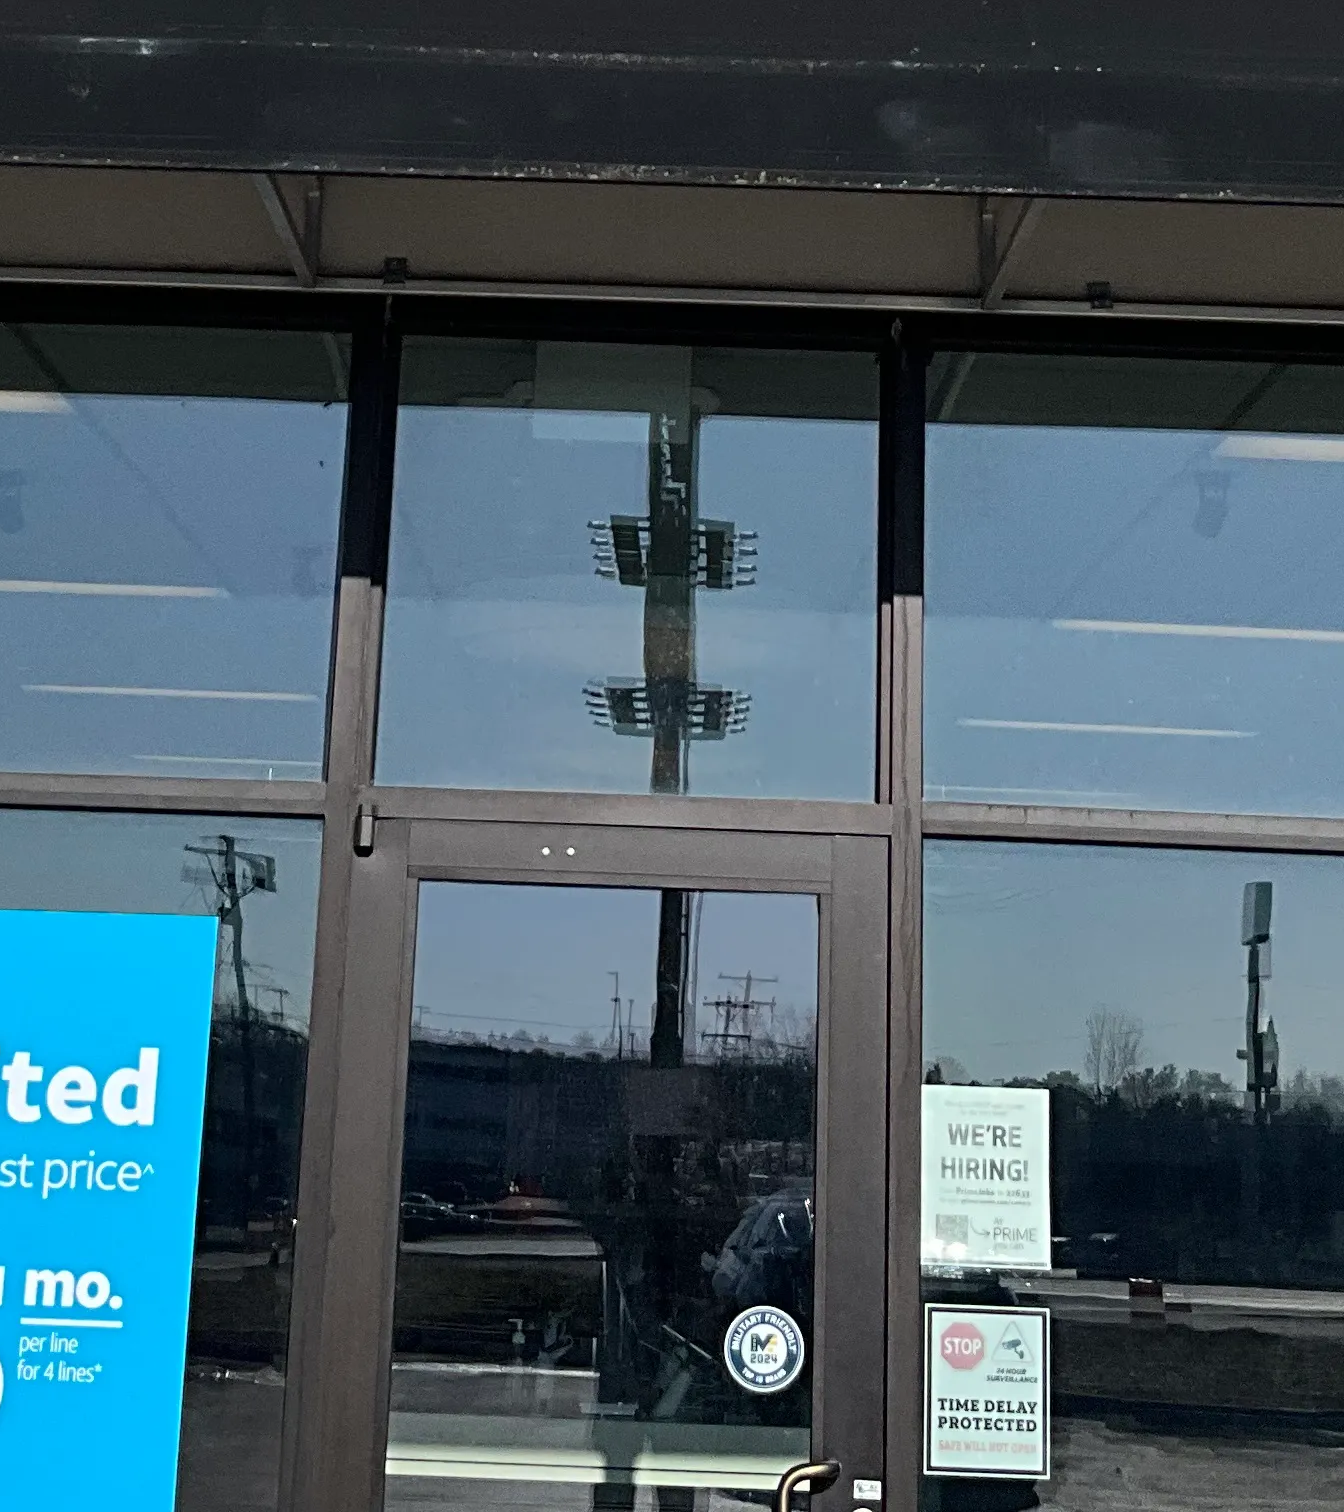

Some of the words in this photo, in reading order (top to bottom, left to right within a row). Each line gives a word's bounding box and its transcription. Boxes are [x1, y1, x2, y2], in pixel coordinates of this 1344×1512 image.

[947, 1122, 1023, 1148] WE'RE
[940, 1156, 1030, 1182] HIRING!
[993, 1227, 1038, 1243] PRIME
[23, 1269, 123, 1310] mo.
[731, 1313, 762, 1350] MILITARY
[765, 1313, 797, 1355] FRIENDLY
[18, 1336, 47, 1357] per
[49, 1332, 79, 1354] line
[943, 1337, 982, 1355] STOP
[750, 1354, 778, 1364] 2024
[17, 1358, 41, 1380] for
[43, 1361, 55, 1381] 4
[986, 1375, 1038, 1384] SURVEILLANCE
[937, 1397, 980, 1412] TIME
[983, 1399, 1038, 1414] DELAY
[937, 1415, 1038, 1432] PROTECTED
[963, 1440, 986, 1452] WILL
[988, 1441, 1009, 1452] NOT
[1010, 1442, 1038, 1454] OPEN
